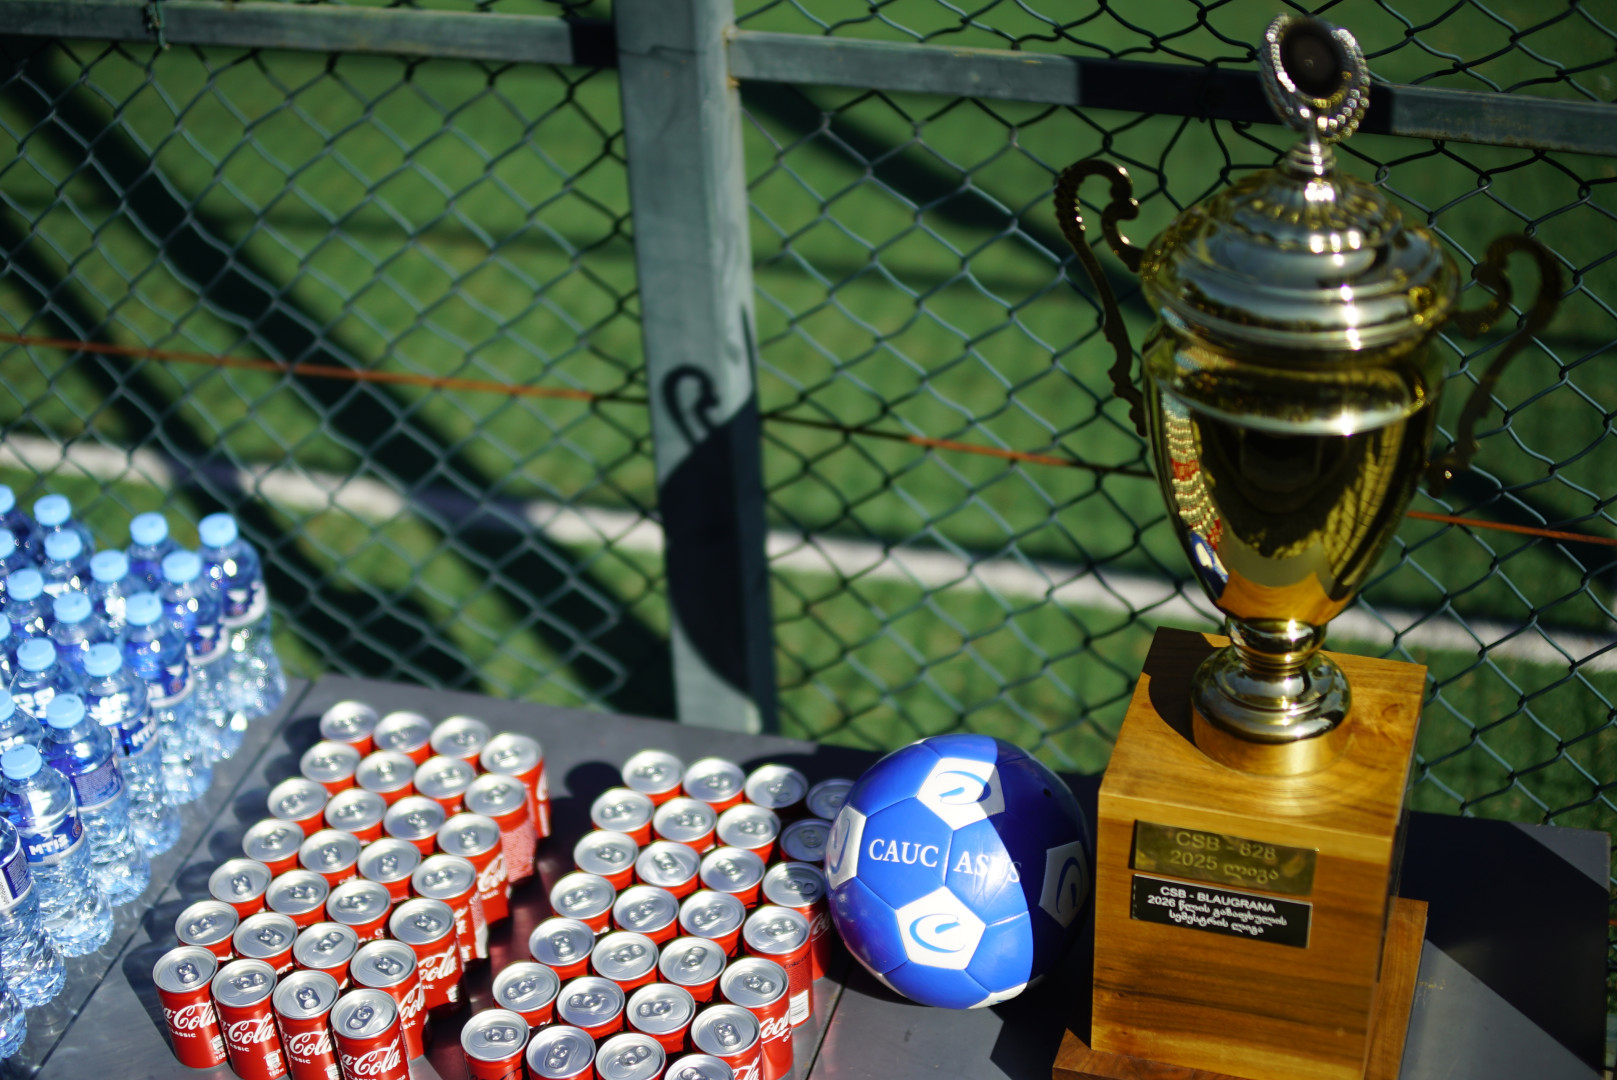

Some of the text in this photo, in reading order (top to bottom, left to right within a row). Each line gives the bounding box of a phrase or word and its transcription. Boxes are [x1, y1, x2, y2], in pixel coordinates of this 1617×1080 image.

[868, 838, 939, 867] CAUC
[1176, 831, 1220, 851] CSB
[1170, 850, 1279, 885] 2025 ლიგა
[1147, 894, 1176, 908] 2026
[1160, 886, 1187, 899] CSB
[1196, 891, 1276, 914] BLAUGRANA
[1230, 922, 1264, 936] ლიგა
